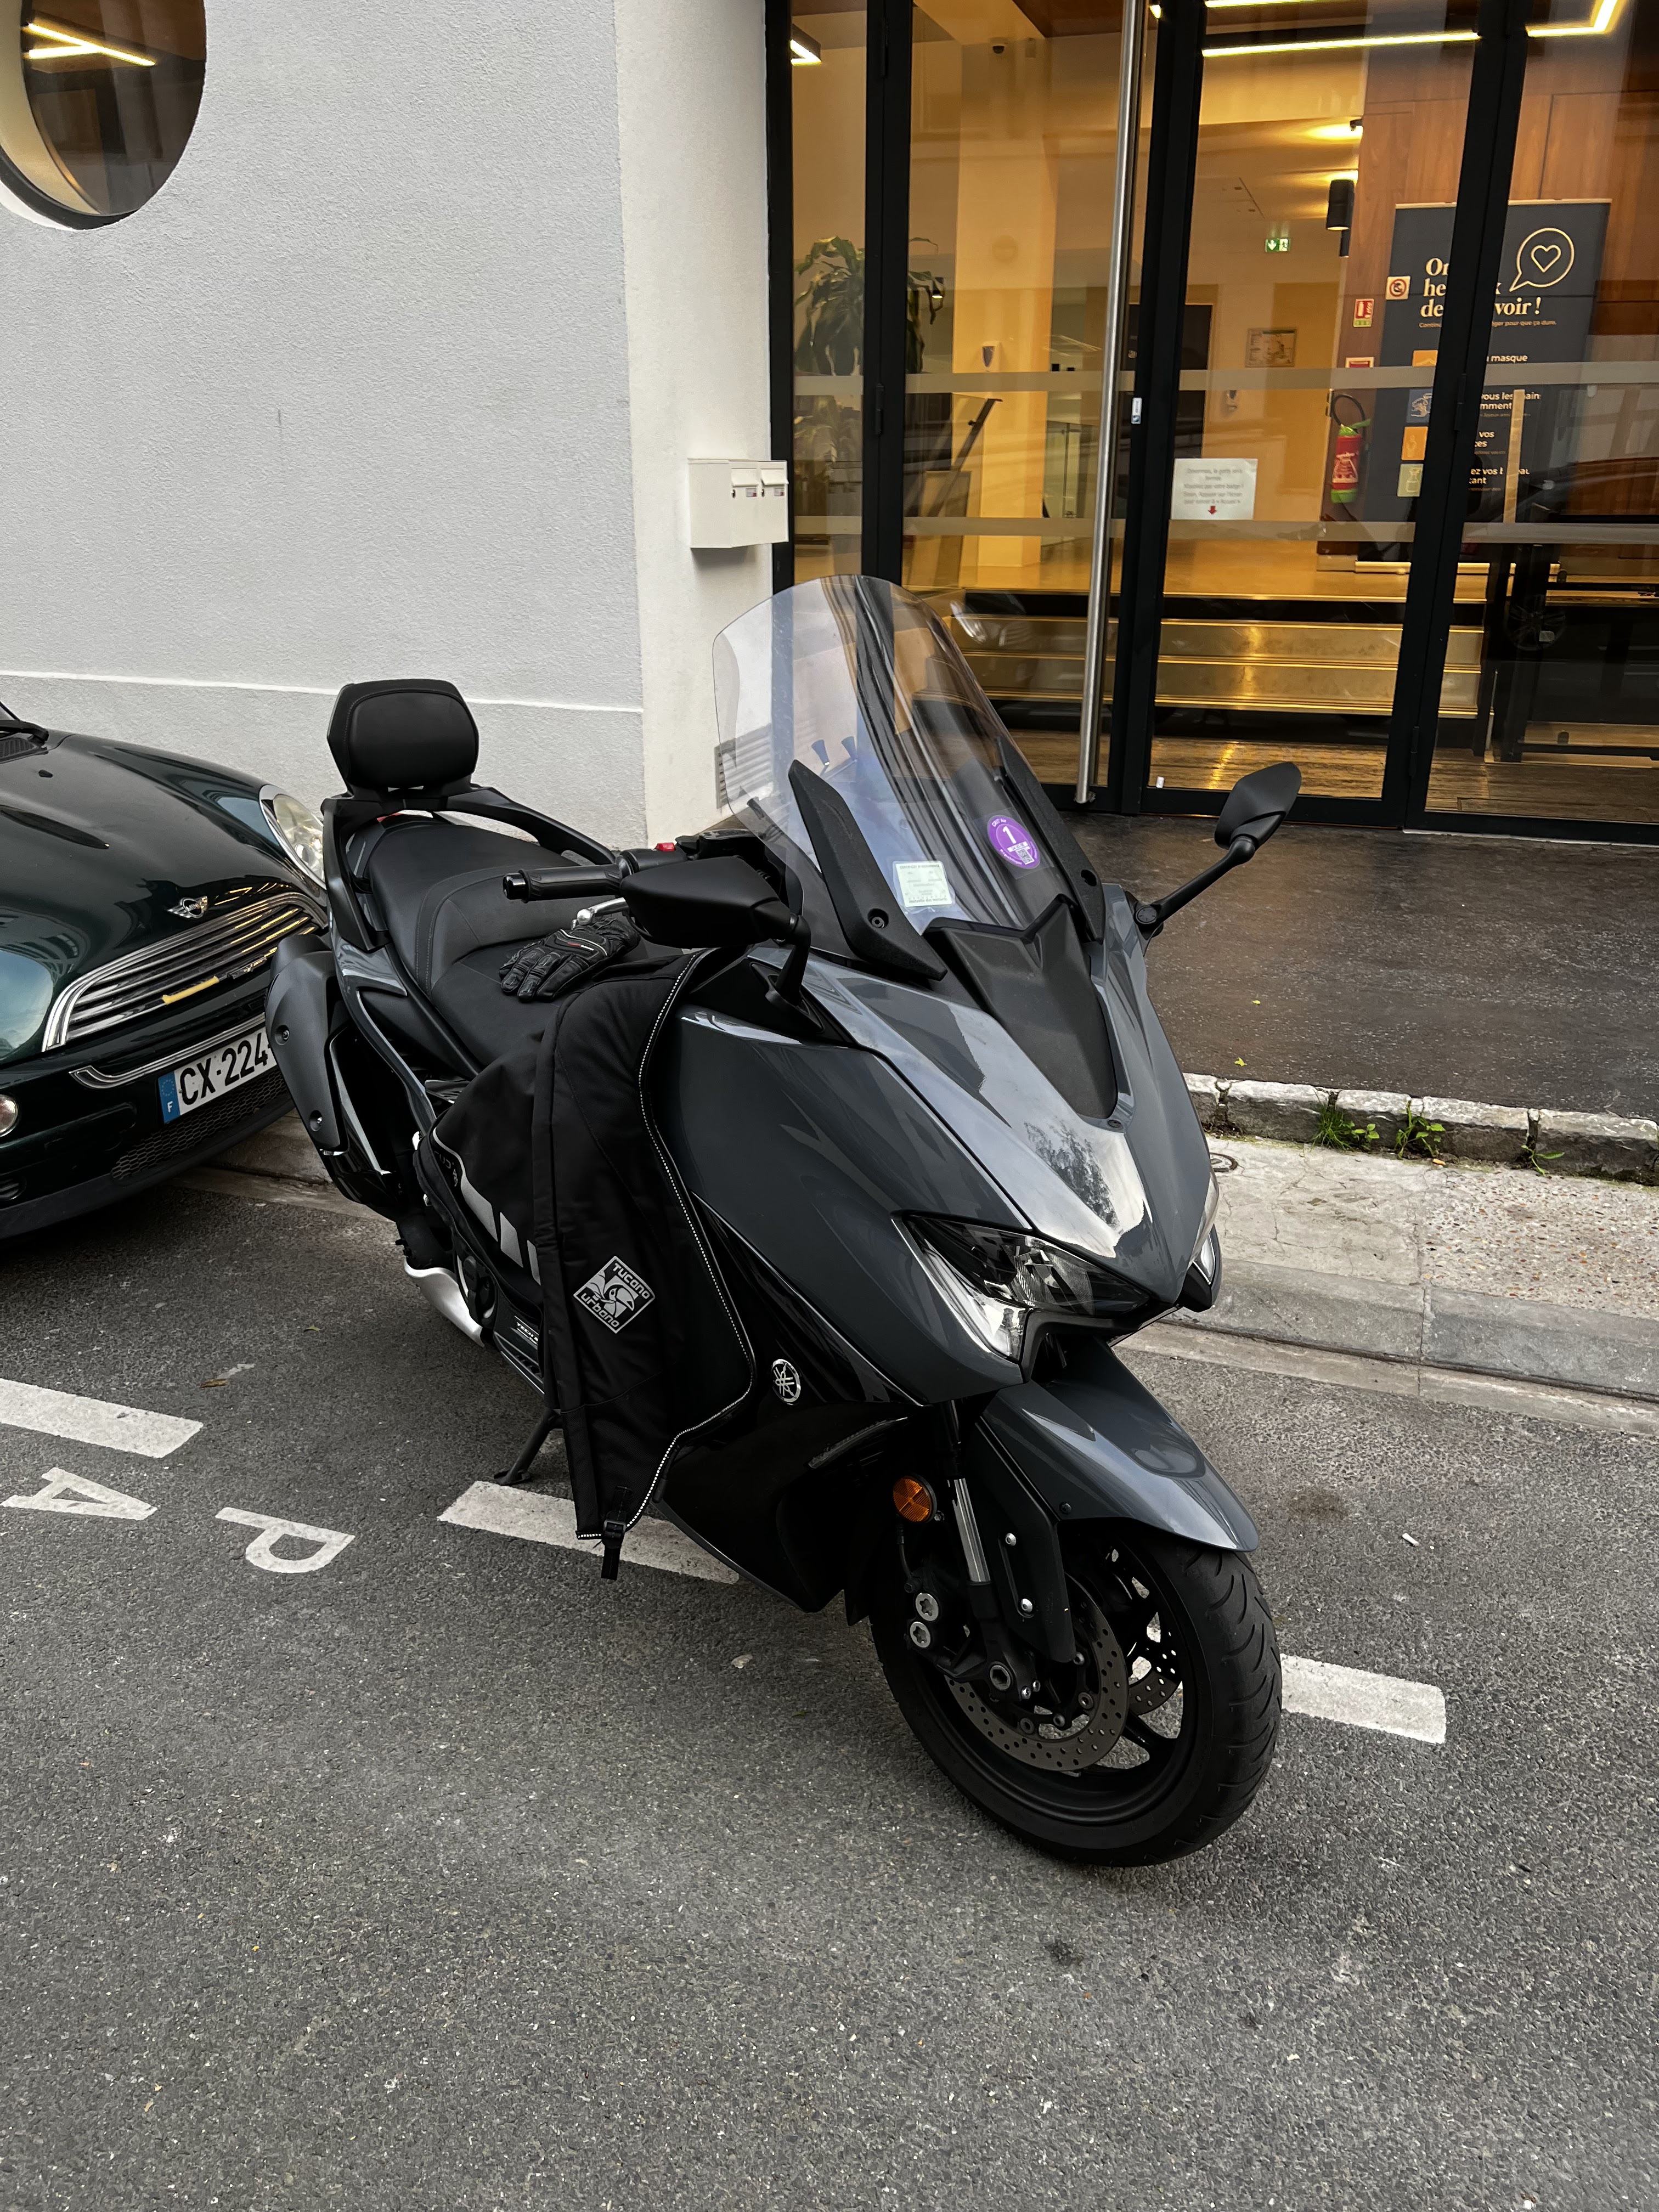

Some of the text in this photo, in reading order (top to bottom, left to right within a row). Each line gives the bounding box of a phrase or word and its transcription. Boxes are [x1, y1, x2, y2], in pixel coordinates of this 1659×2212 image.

[1002, 826, 1017, 845] 1
[179, 1032, 270, 1106] CX-224
[167, 1101, 173, 1114] F
[215, 1506, 356, 1573] P
